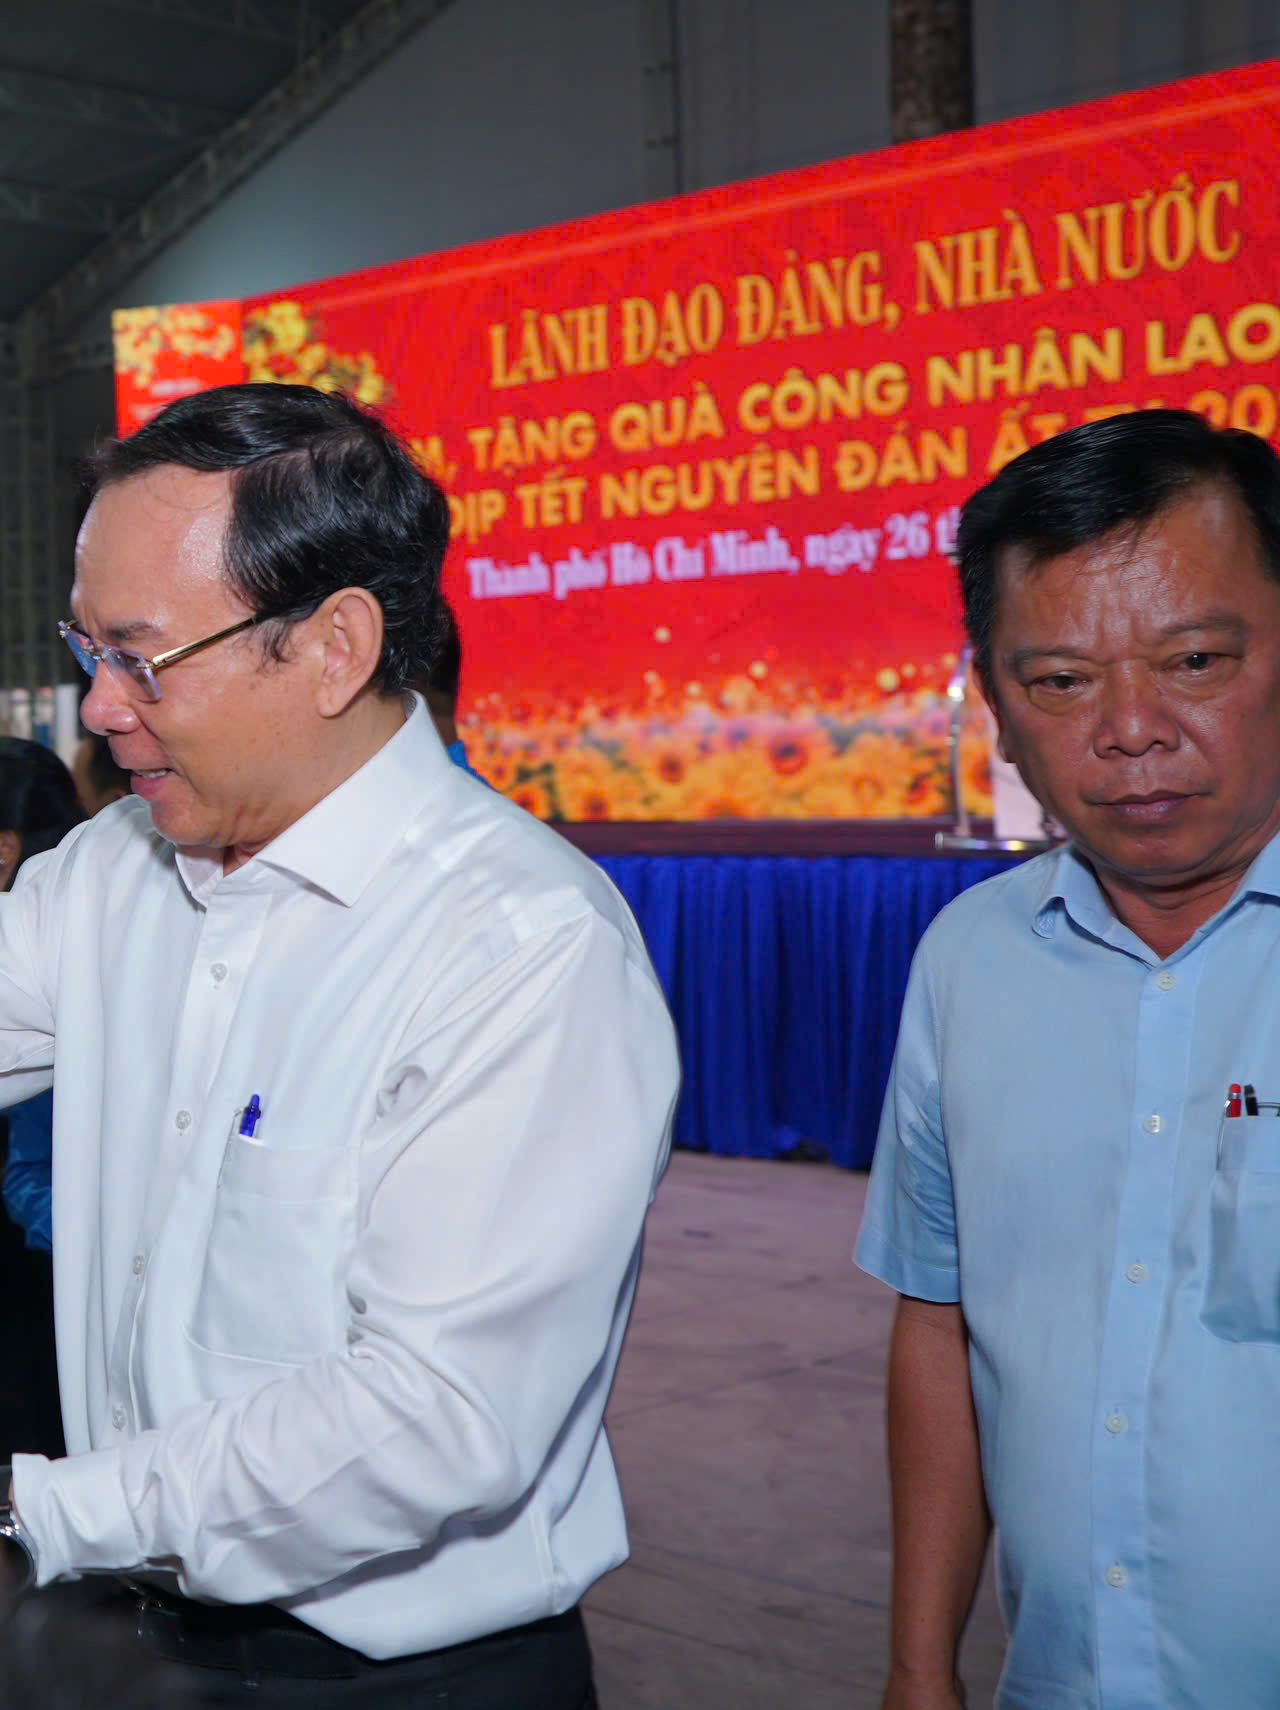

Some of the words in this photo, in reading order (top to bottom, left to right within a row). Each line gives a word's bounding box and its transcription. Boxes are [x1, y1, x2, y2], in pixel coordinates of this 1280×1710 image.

[489, 304, 609, 389] LÃNH
[621, 283, 723, 367] ĐẠO
[737, 250, 900, 345] ĐẢNG,
[914, 210, 1041, 313] NHÀ
[1056, 172, 1240, 290] NƯỚC
[467, 411, 597, 477] TẶNG
[610, 381, 724, 450] QUÀ
[739, 362, 909, 434] CÔNG
[927, 327, 1122, 406] NHÂN
[1145, 303, 1280, 376] LAO
[516, 466, 586, 528] TẾT
[600, 442, 820, 519] NGUYÊN
[834, 422, 968, 491] ĐÁN
[710, 525, 801, 576] Minh,
[884, 511, 929, 560] 26
